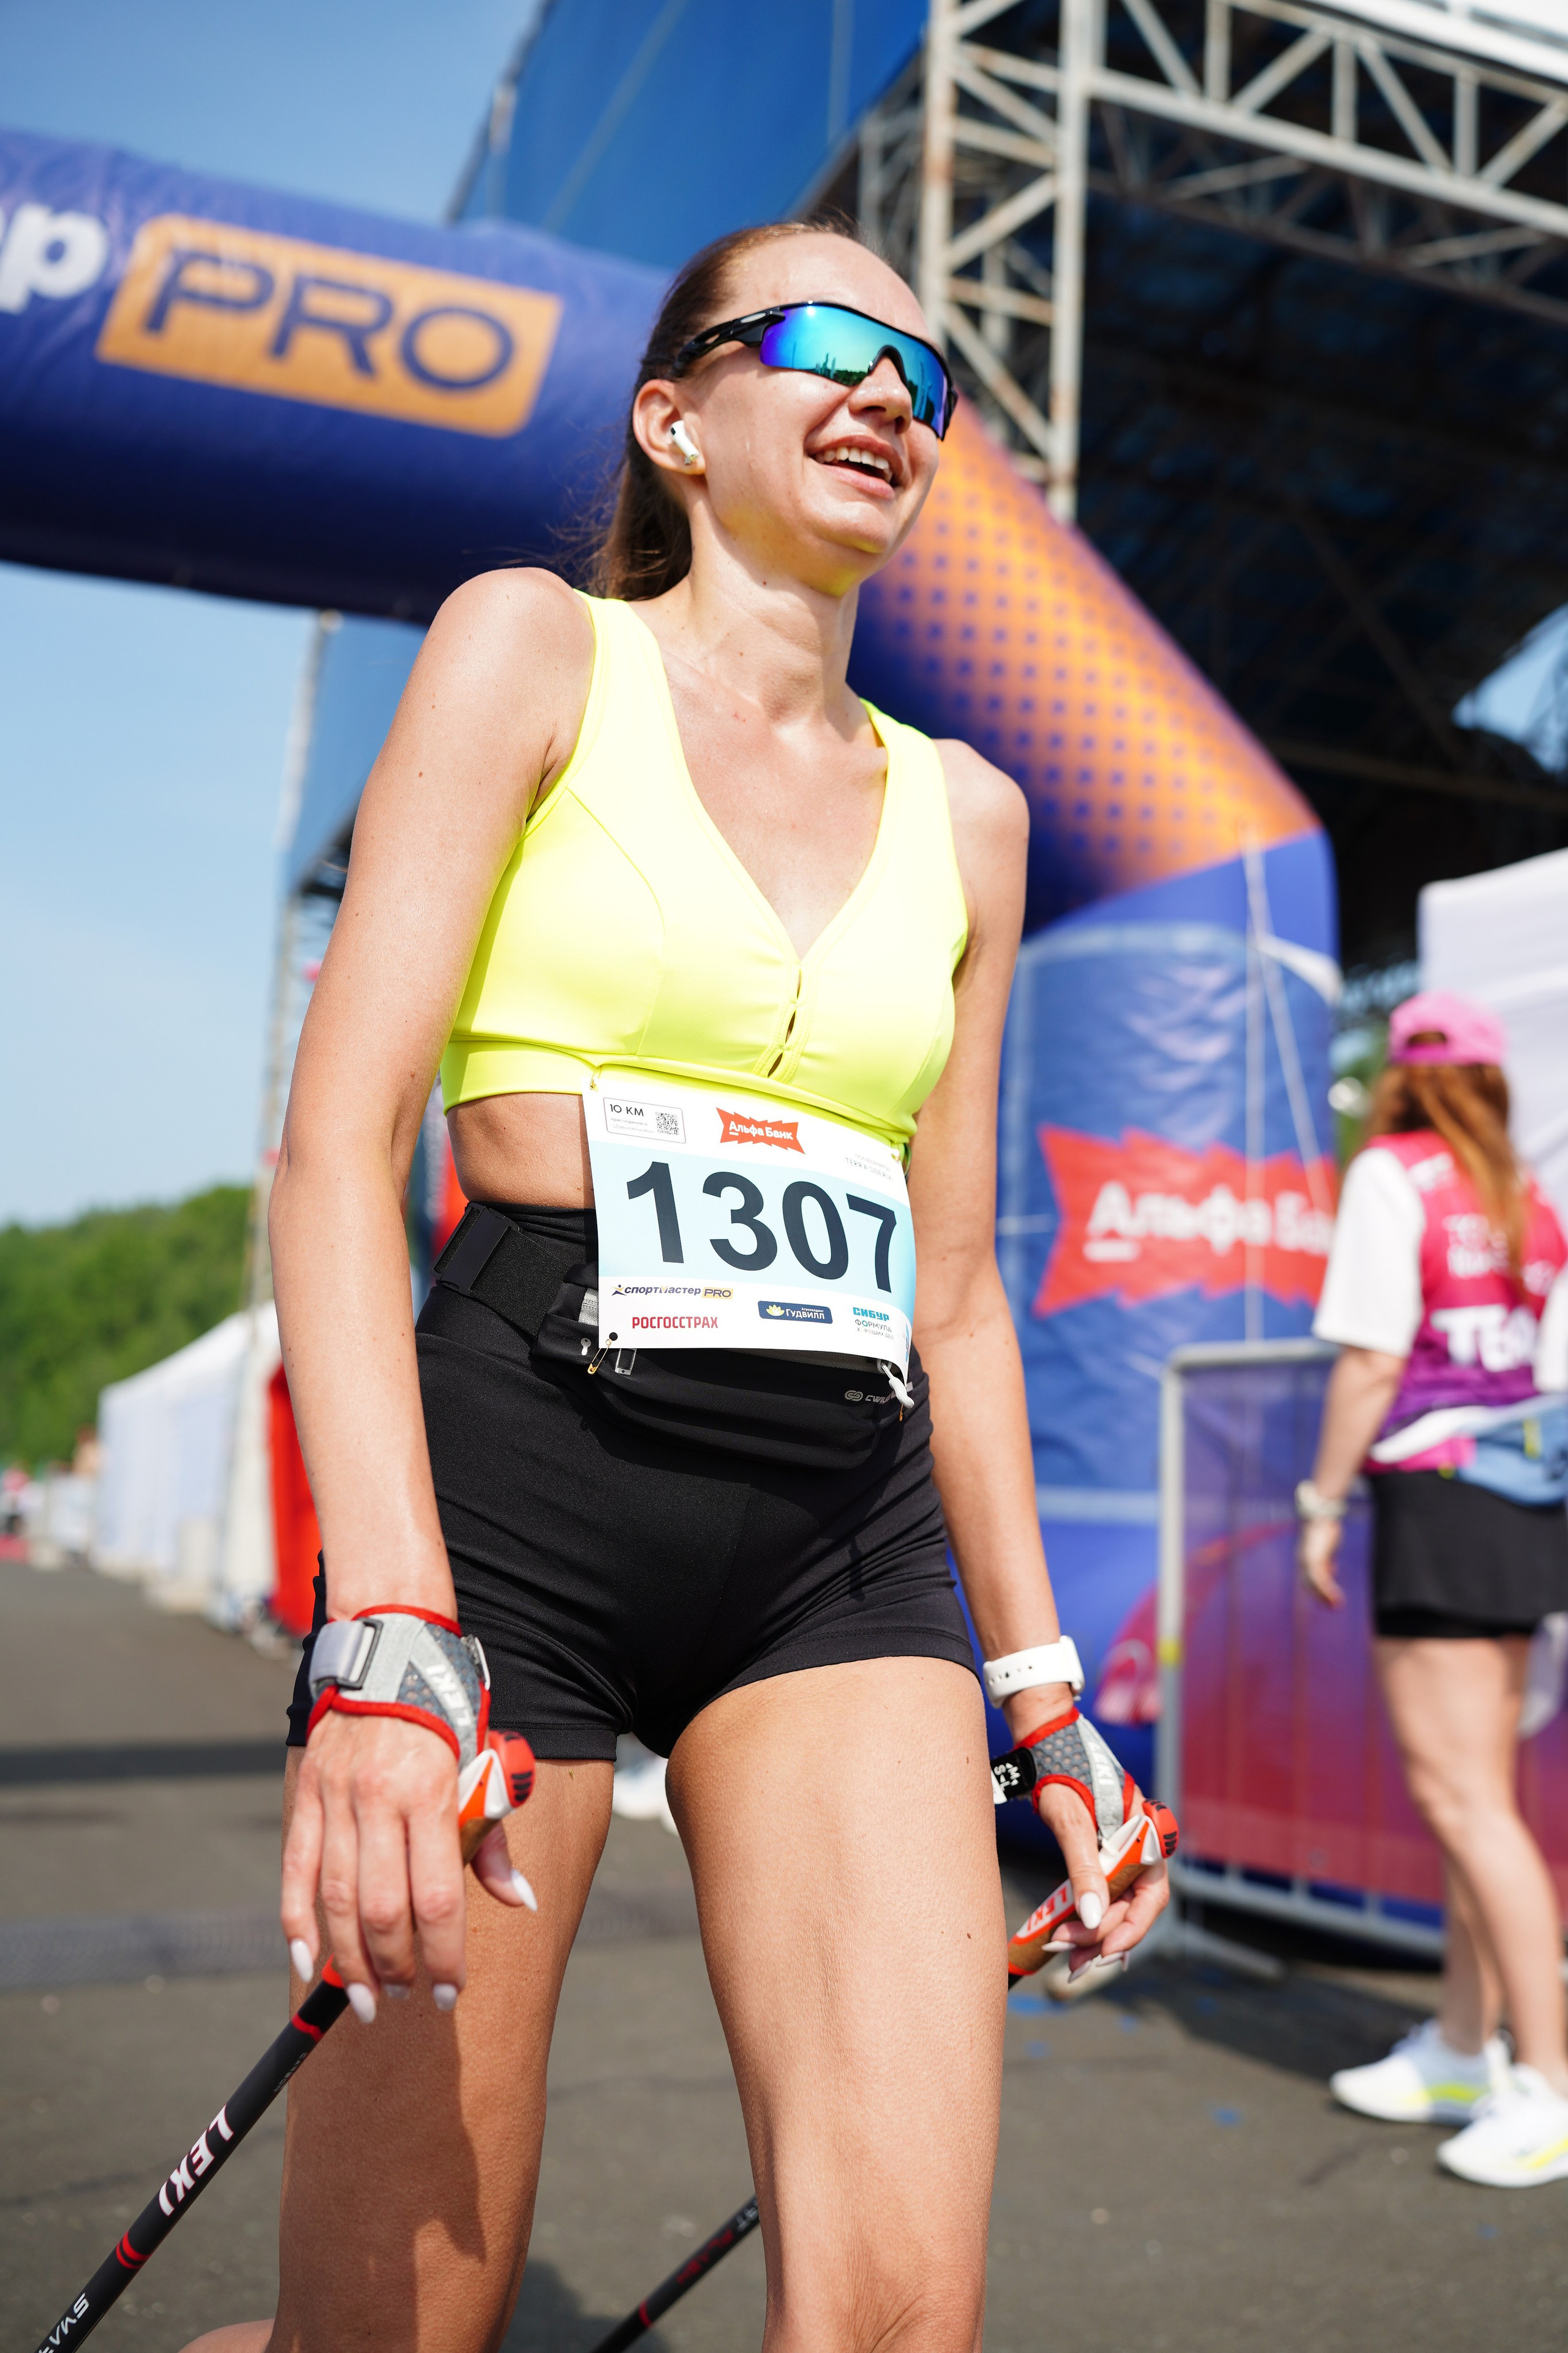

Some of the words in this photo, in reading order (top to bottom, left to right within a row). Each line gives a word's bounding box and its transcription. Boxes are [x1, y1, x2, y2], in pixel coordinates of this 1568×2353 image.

[145, 247, 514, 392] PRO
[609, 1104, 622, 1113] 10
[729, 1120, 764, 1137] Альфа
[764, 1127, 794, 1140] Банк
[627, 1161, 897, 1293] 1307
[704, 1288, 732, 1297] PRO
[632, 1316, 718, 1329] РОСГОССТРАХ
[853, 1307, 890, 1321] СИБУР
[855, 1319, 892, 1333] ФОРМУЛА
[426, 1664, 471, 1726] LEKI
[1027, 1885, 1067, 1932] LEKI
[159, 2105, 234, 2216] LEKI
